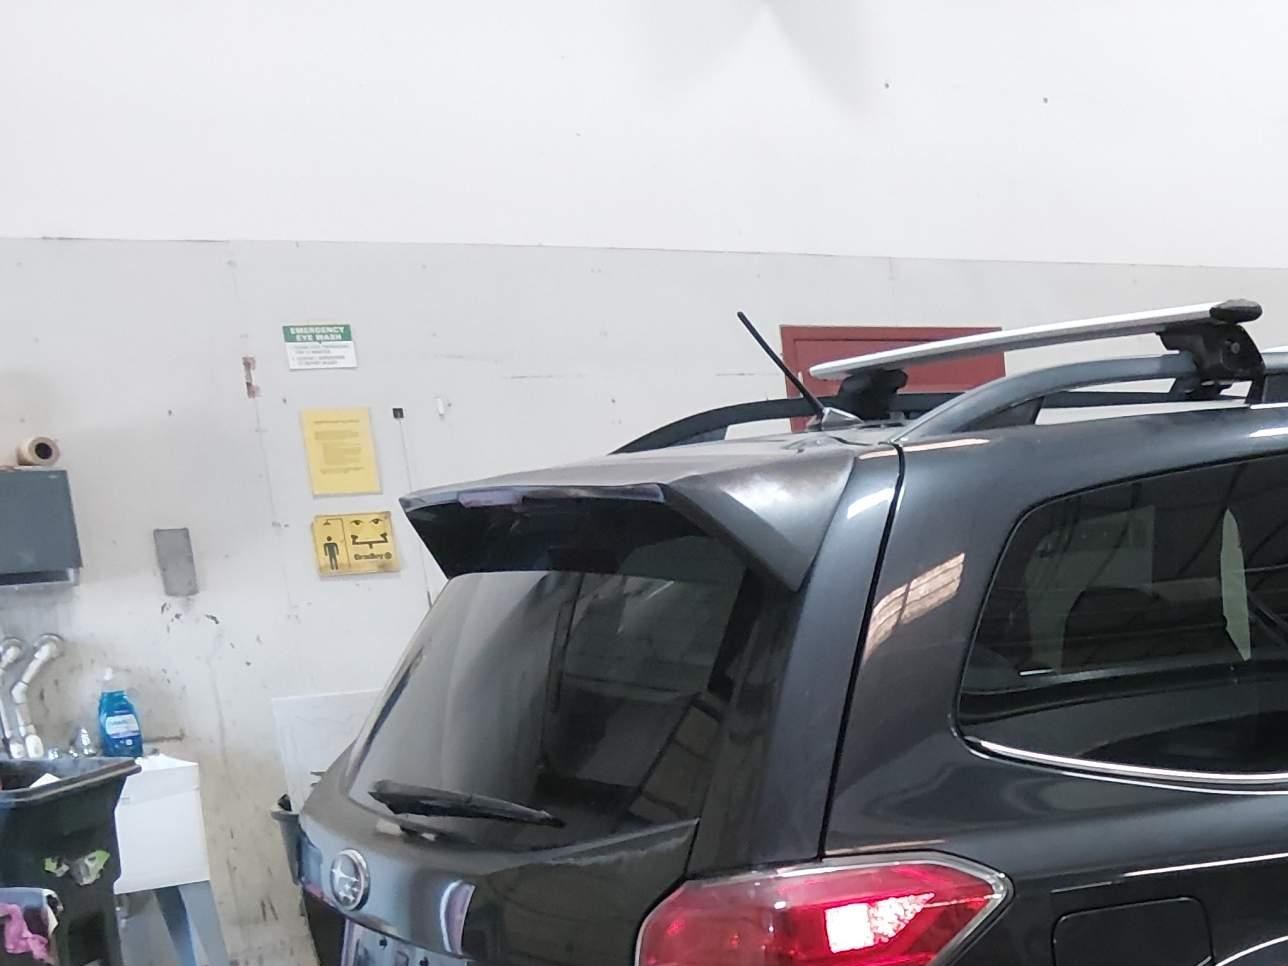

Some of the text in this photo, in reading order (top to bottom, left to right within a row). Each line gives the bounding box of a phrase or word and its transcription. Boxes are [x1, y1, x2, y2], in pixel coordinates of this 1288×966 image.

[290, 326, 345, 335] EMERGENCY
[296, 333, 342, 342] EYE WASH
